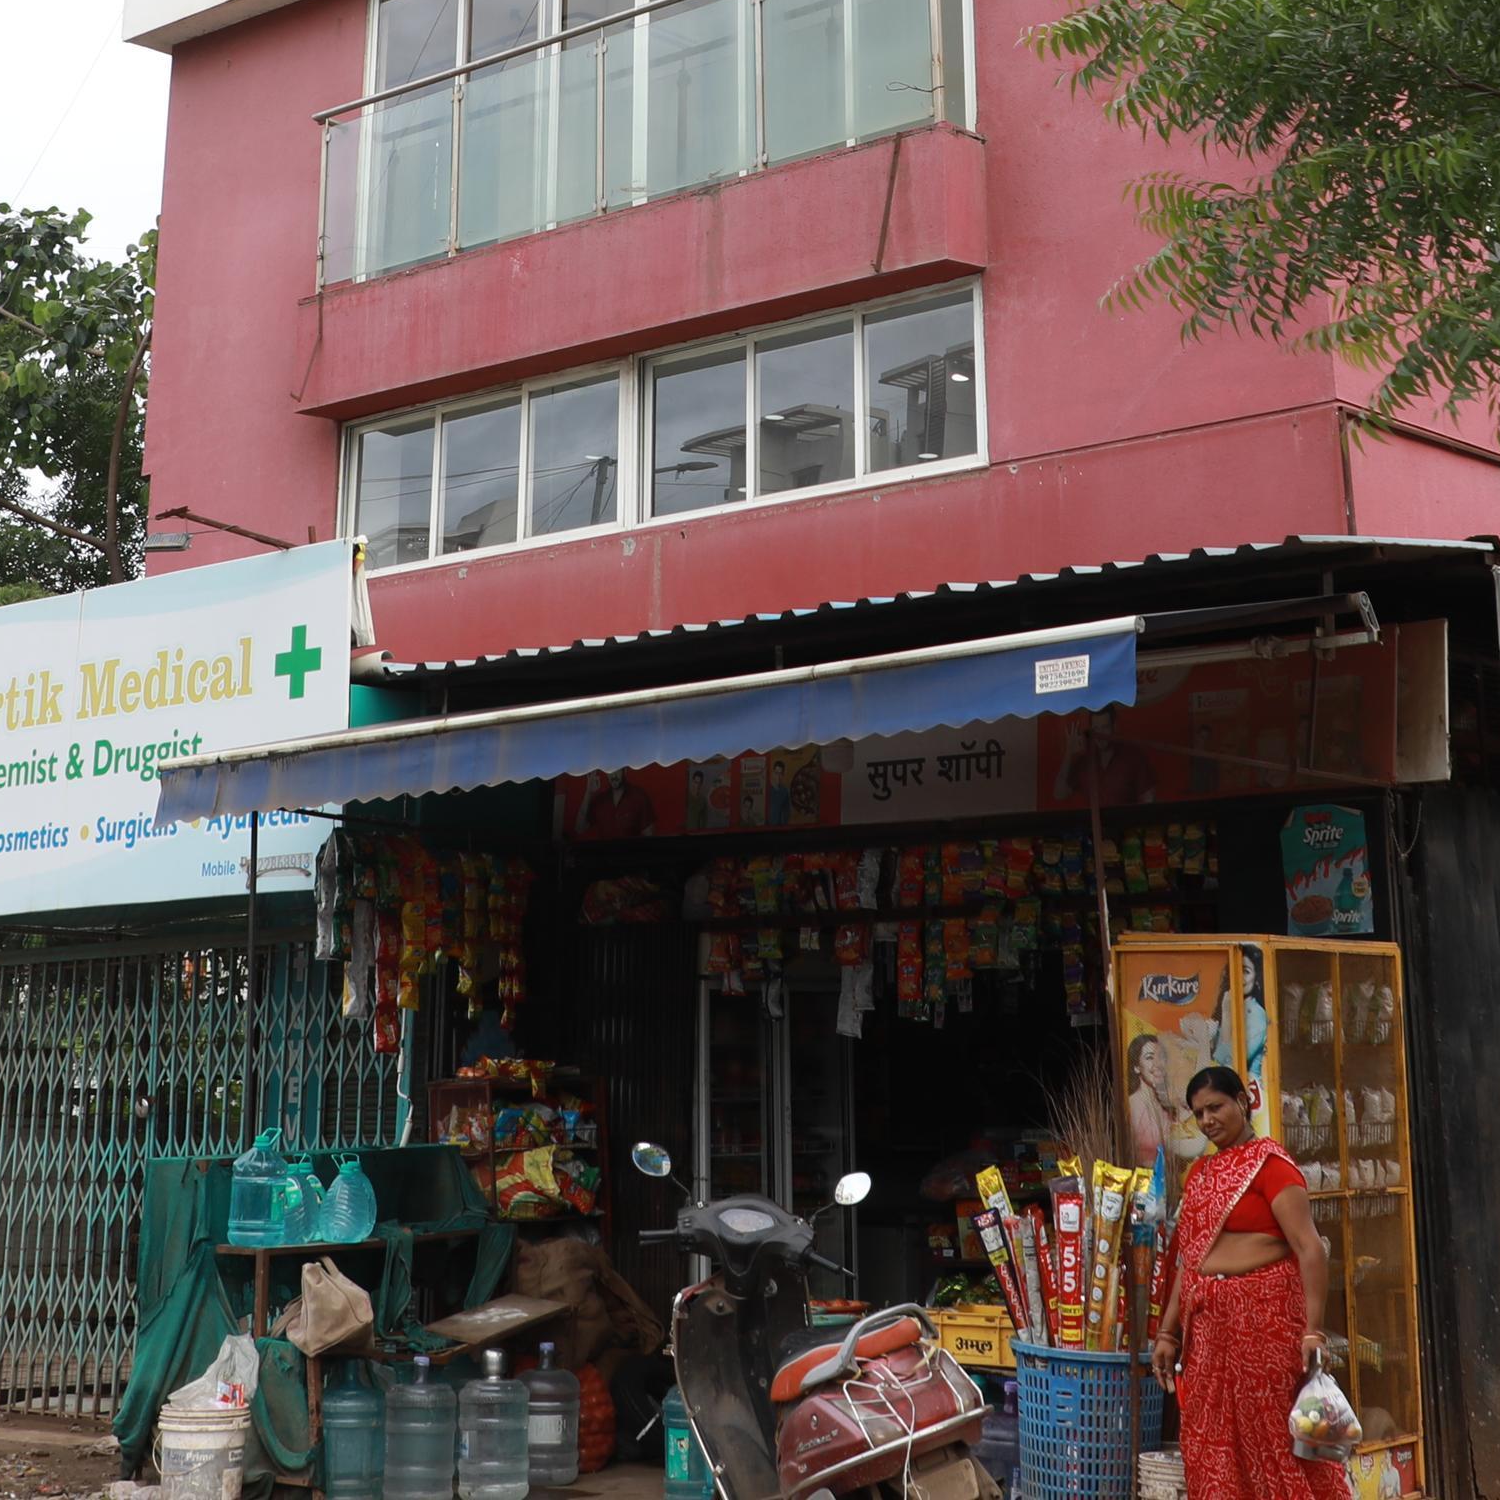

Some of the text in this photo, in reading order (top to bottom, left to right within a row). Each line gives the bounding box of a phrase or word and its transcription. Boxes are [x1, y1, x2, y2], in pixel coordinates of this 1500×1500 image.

[76, 637, 253, 720] Medical
[65, 742, 83, 780] &
[866, 739, 1006, 801] सुपर शॉपी
[1302, 824, 1344, 846] Sprite
[202, 860, 236, 877] Mobile
[1331, 908, 1362, 925] Sprite
[1141, 974, 1199, 999] Kurkure
